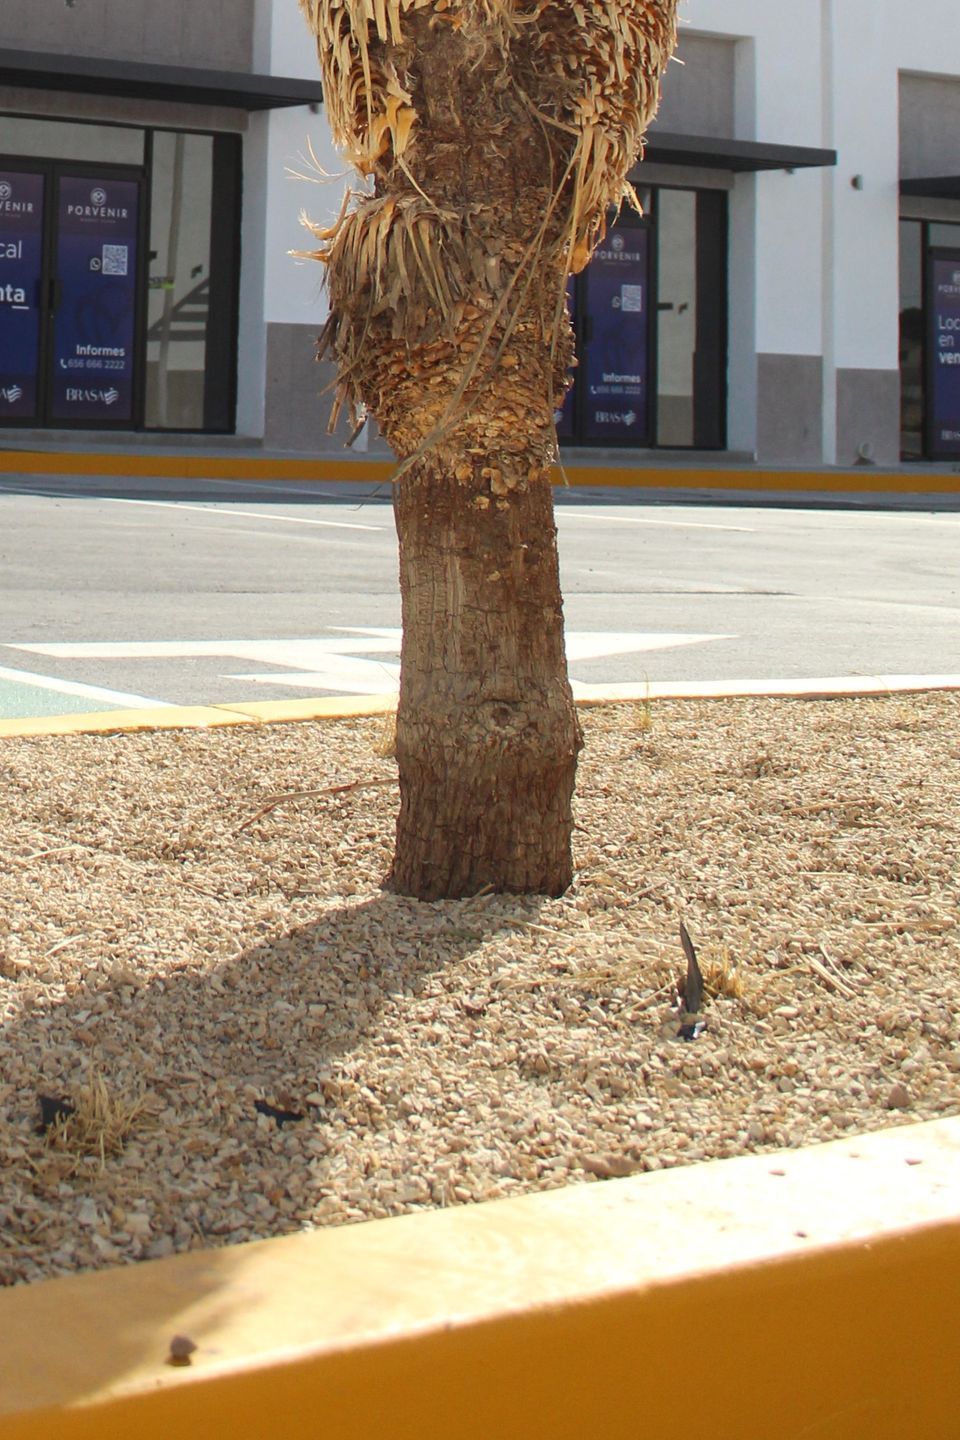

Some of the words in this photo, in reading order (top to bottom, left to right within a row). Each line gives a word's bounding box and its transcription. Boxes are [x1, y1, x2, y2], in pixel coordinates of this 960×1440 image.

[67, 204, 129, 219] PORVENIR
[939, 334, 954, 347] en
[76, 344, 125, 357] Informes
[66, 388, 105, 402] BRASA
